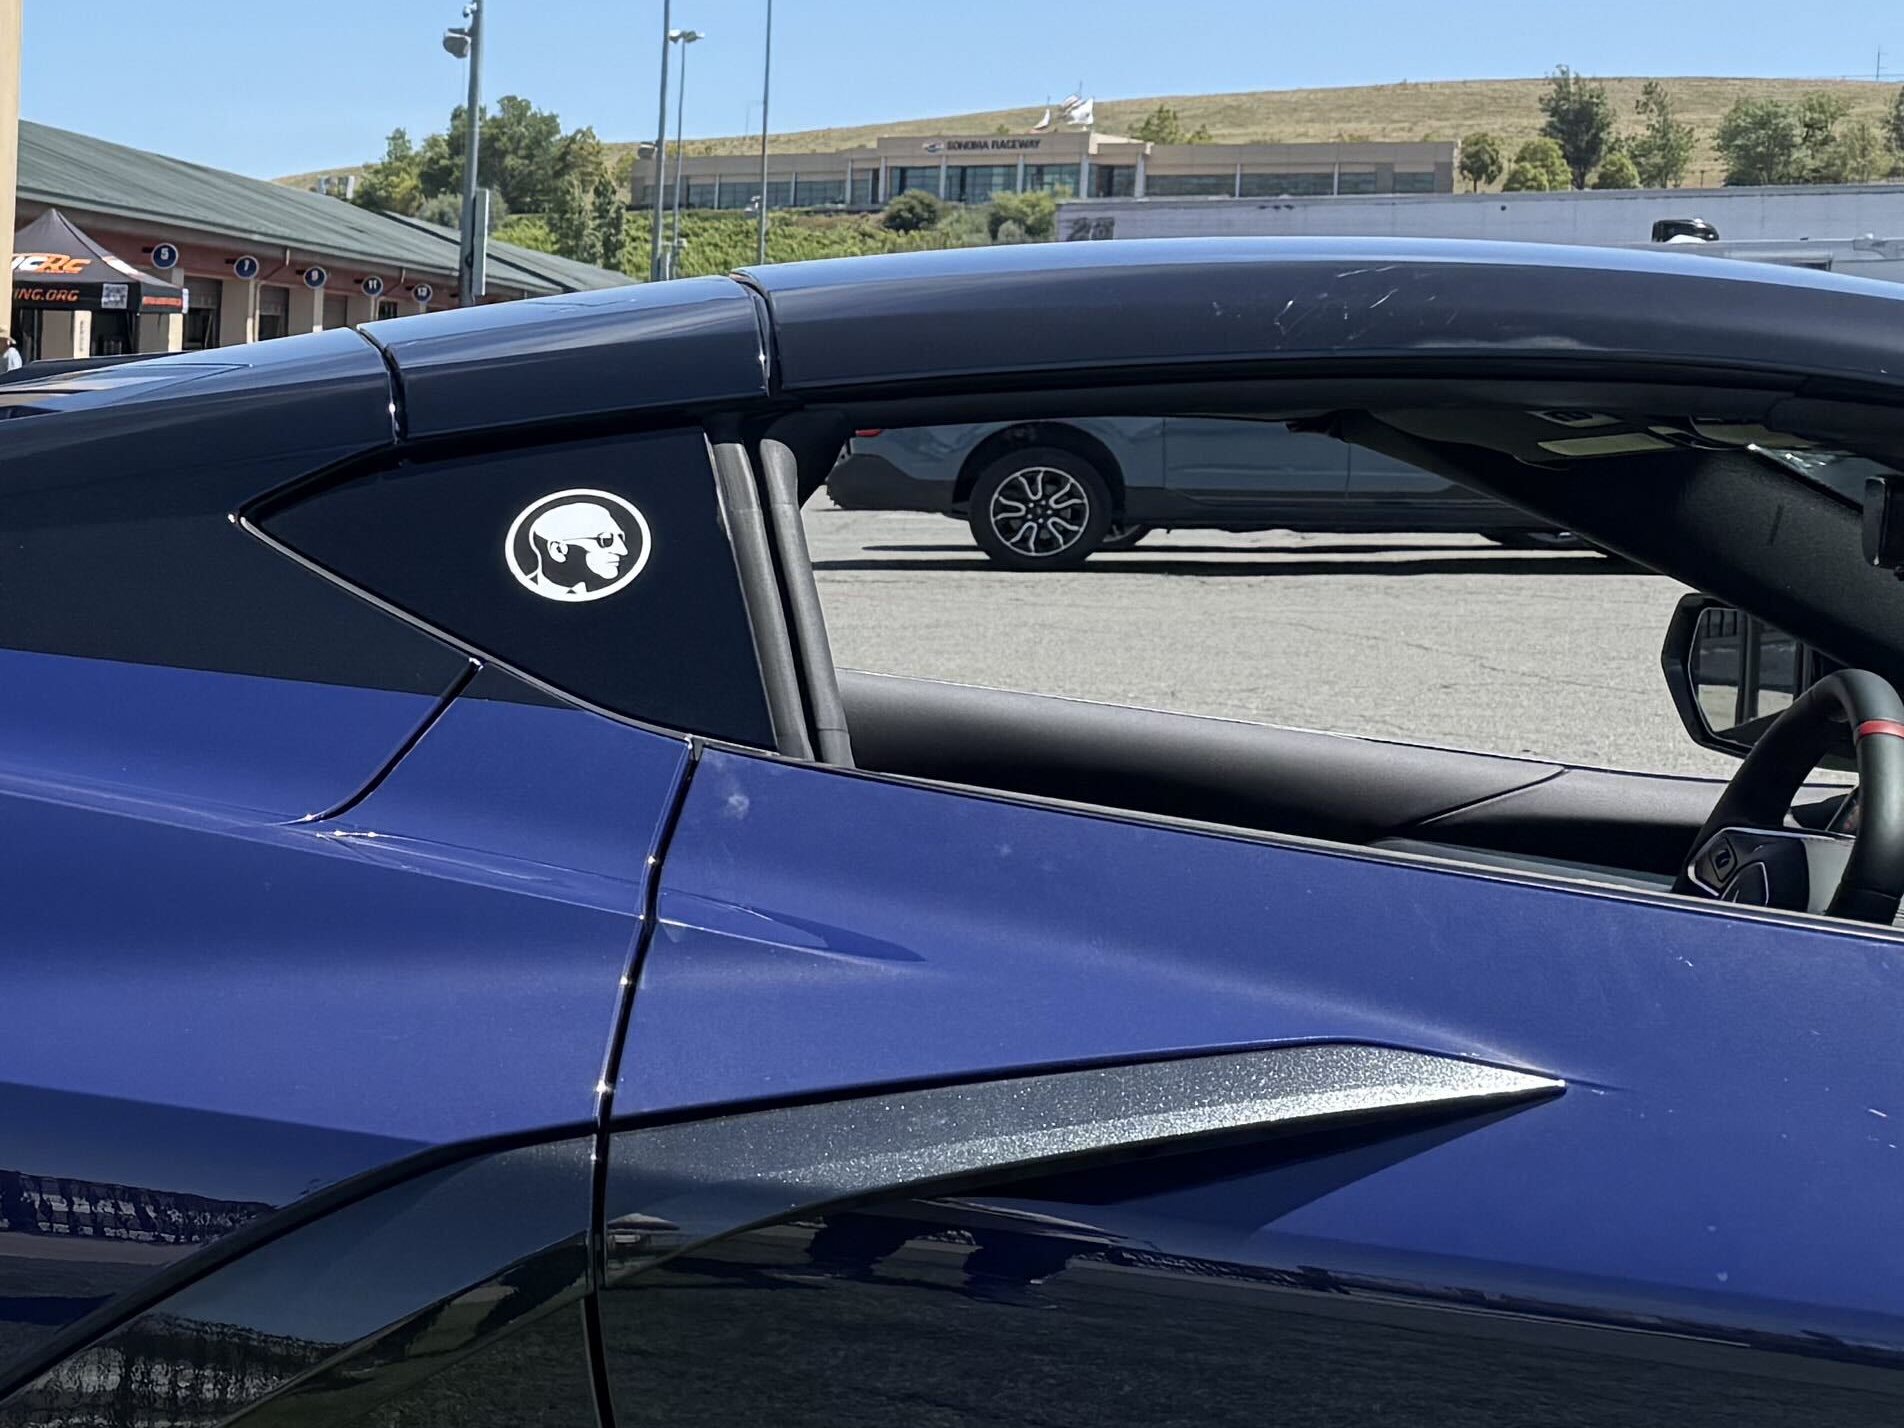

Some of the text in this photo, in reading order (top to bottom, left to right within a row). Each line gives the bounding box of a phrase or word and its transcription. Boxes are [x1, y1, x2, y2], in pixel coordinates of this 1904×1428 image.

[947, 138, 1041, 151] SONOMA RACEWAY
[160, 247, 169, 261] 5
